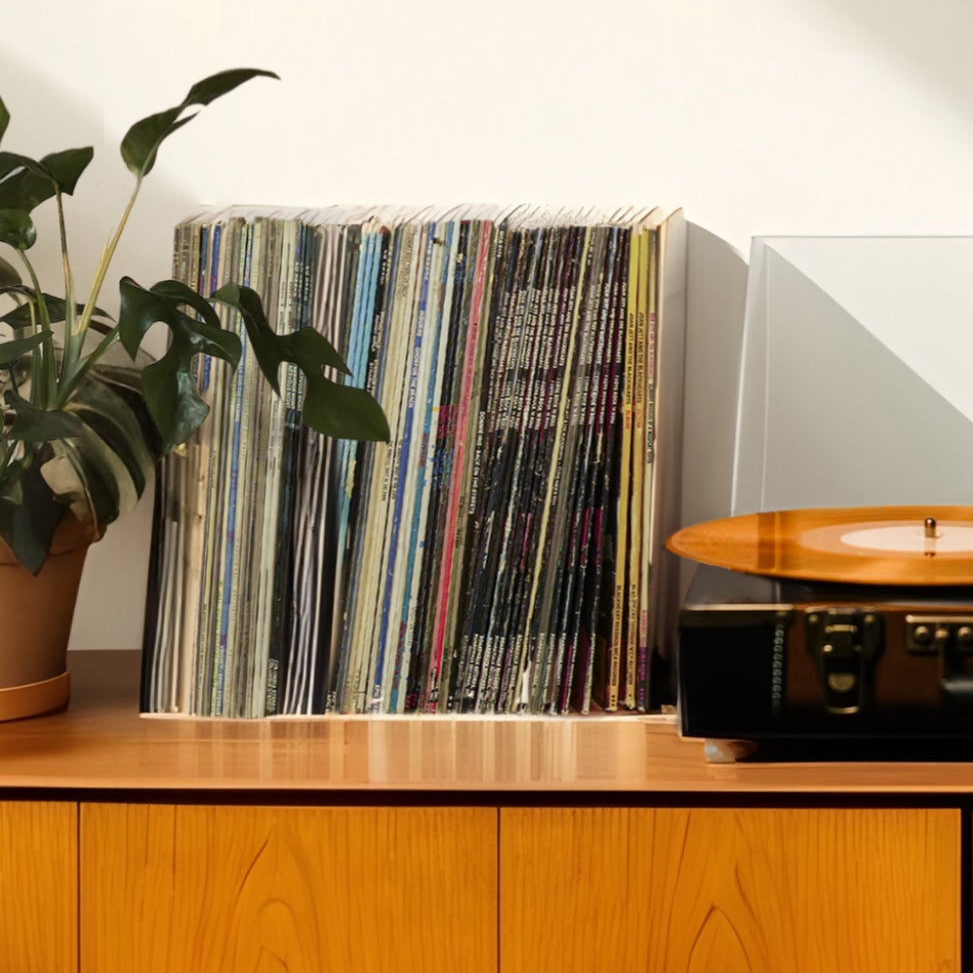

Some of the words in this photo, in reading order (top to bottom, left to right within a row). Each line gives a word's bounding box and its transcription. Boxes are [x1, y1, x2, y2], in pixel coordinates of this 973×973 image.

[477, 411, 485, 433] DONNIE
[474, 450, 482, 465] BACK
[473, 467, 480, 476] ON
[469, 488, 478, 514] STREETS
